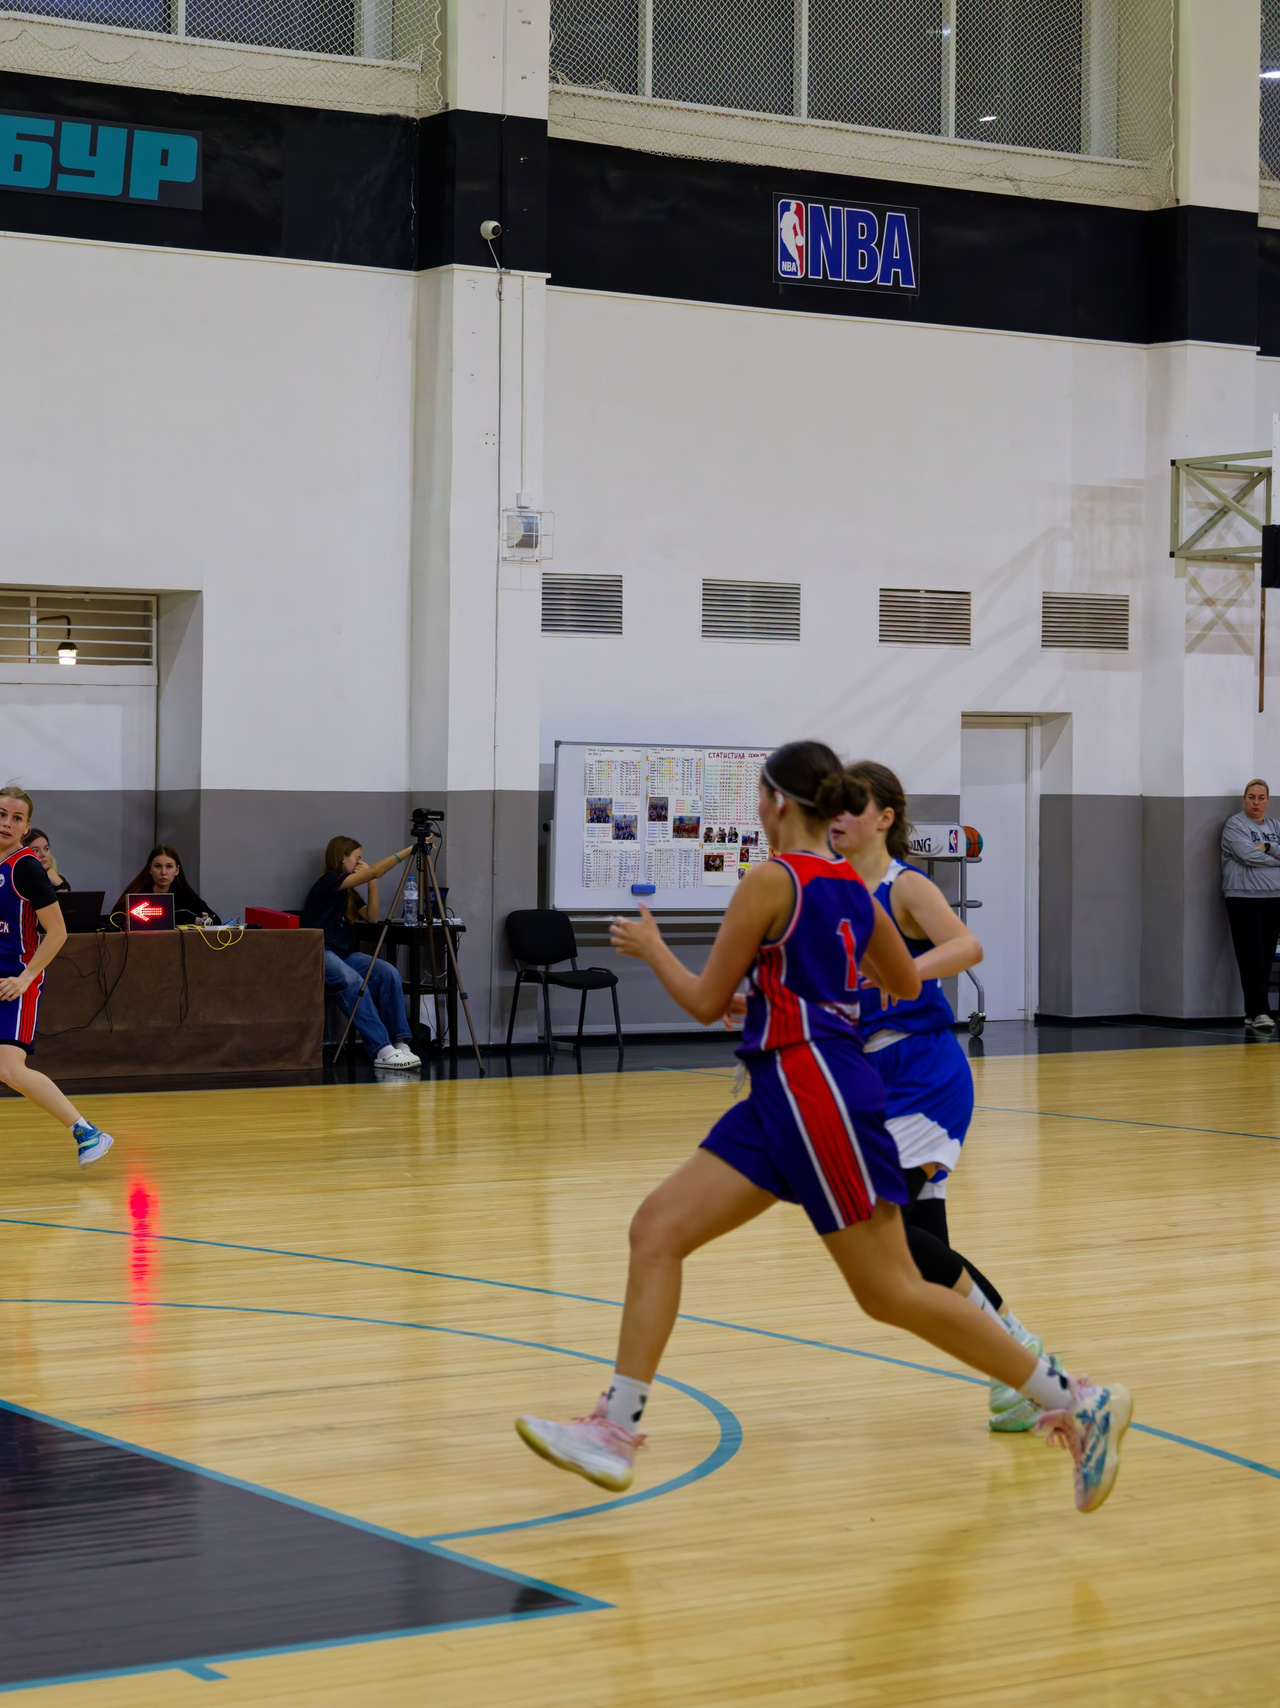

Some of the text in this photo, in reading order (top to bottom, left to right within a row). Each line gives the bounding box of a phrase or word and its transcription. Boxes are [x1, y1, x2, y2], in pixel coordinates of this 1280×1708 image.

[808, 203, 916, 288] NBA
[781, 261, 797, 273] NBA
[708, 752, 745, 760] СТАТИСТИКА
[836, 918, 859, 991] 1
